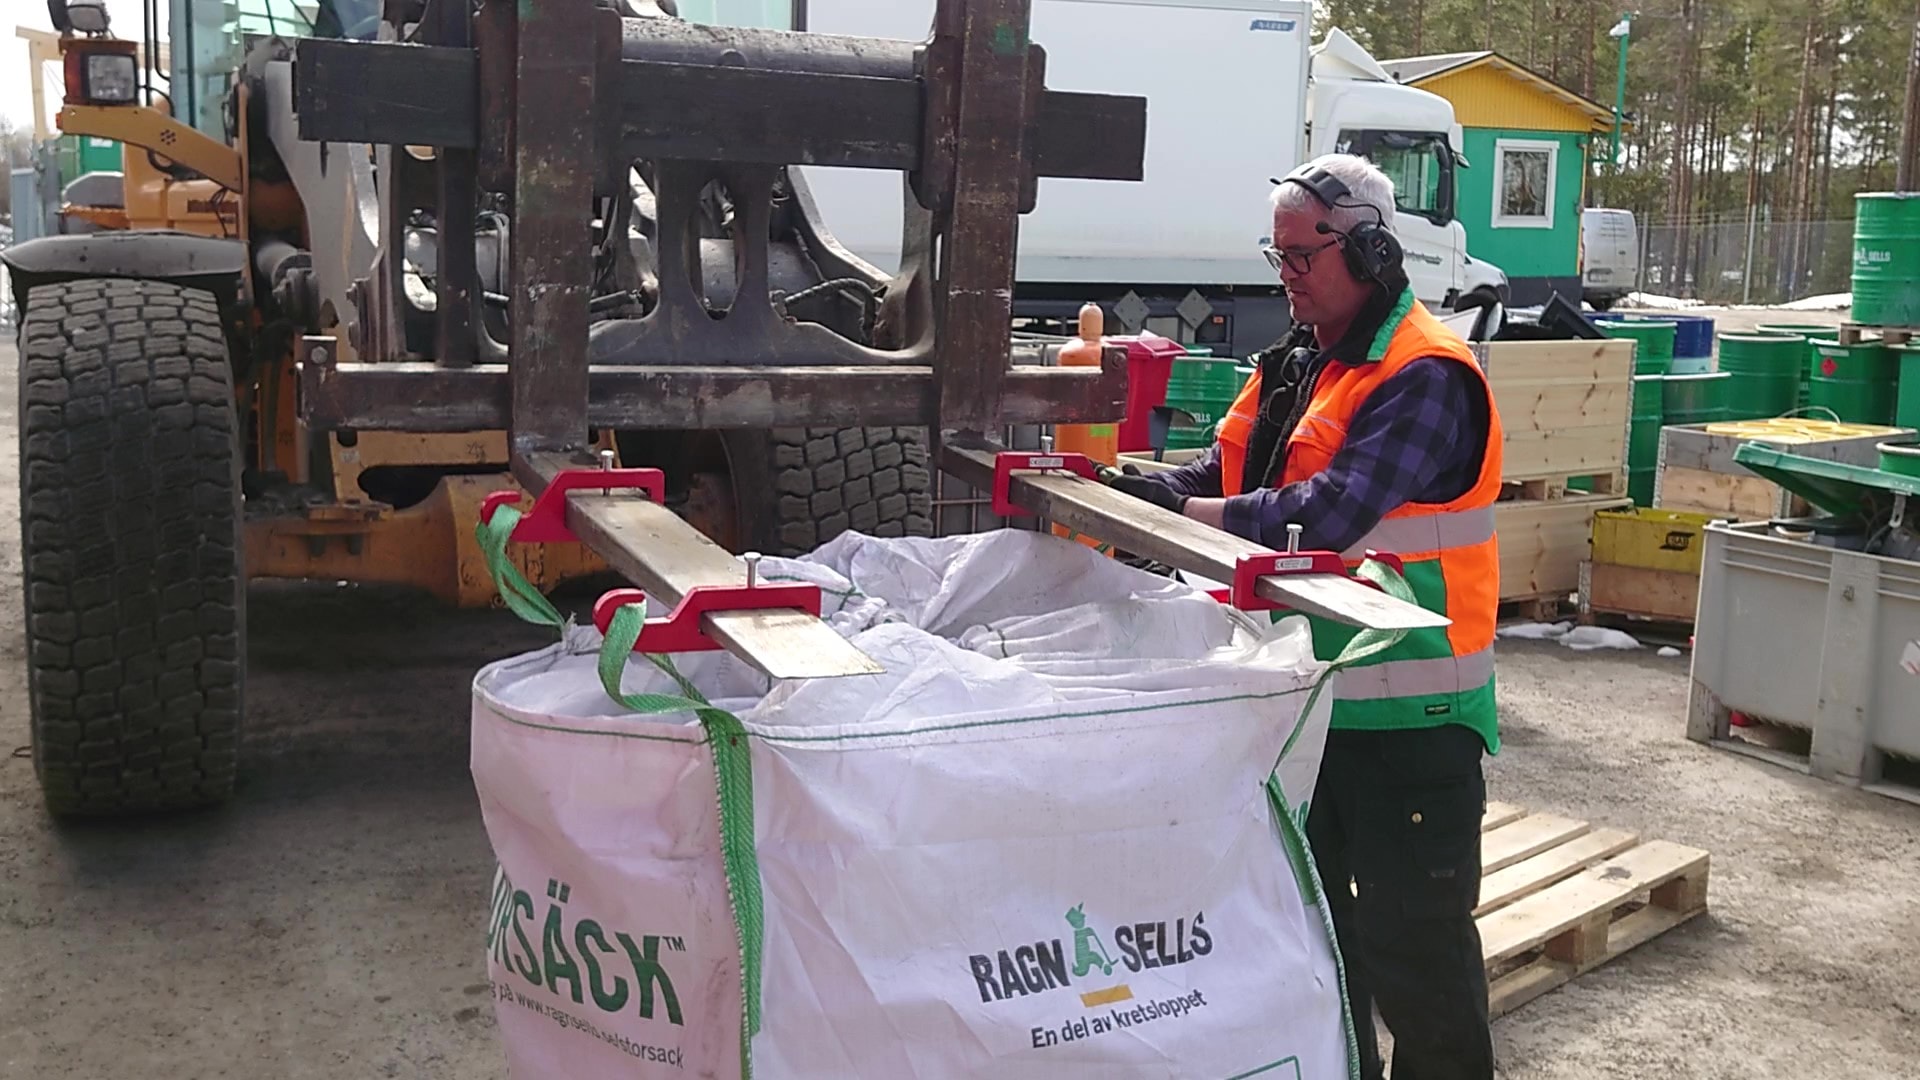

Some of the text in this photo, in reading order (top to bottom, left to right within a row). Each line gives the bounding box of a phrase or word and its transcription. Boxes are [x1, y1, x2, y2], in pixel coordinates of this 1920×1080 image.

[1193, 412, 1211, 424] ELLS
[969, 910, 1213, 1003] RAGN SELLS
[500, 983, 514, 1003] på
[1031, 989, 1208, 1048] En del av kretsloppet
